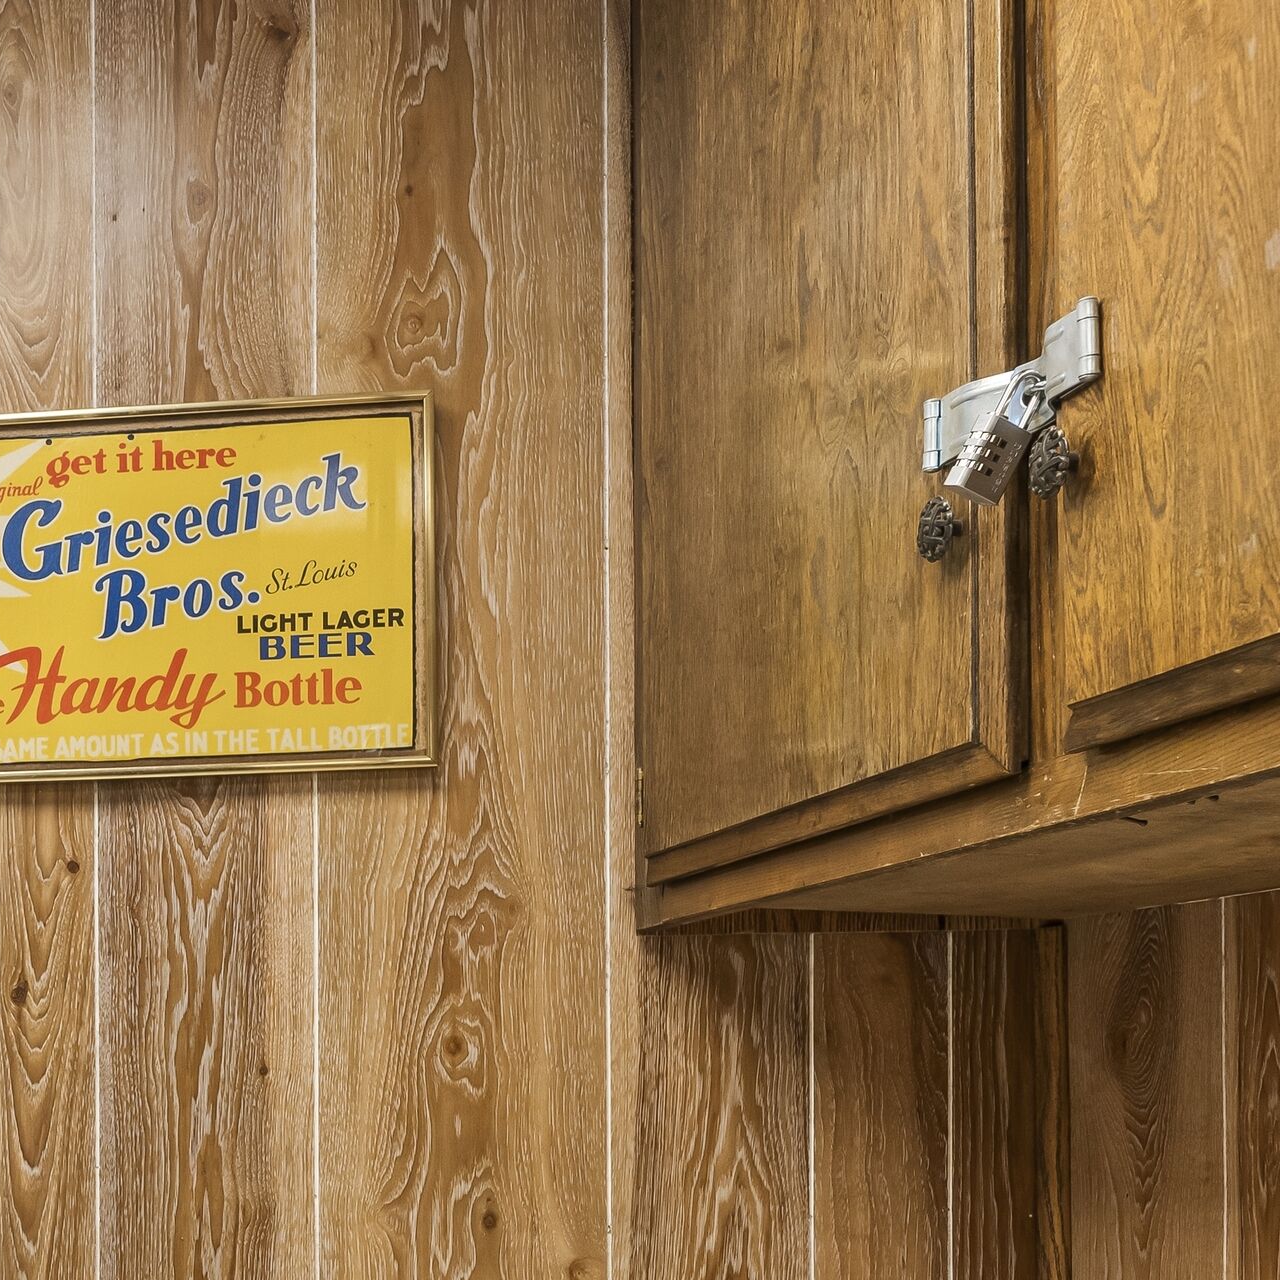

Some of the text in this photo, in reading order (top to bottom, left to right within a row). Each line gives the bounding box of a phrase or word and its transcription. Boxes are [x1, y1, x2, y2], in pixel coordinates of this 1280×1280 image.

[46, 440, 237, 488] get it here
[1, 451, 367, 581] Griesedieck
[95, 569, 261, 639] Bros.
[237, 608, 405, 634] LIGHT LAGER
[259, 631, 376, 660] BEER
[233, 668, 362, 708] Bottle
[55, 732, 144, 759] AMOUNT
[150, 731, 179, 755] AS
[185, 730, 207, 754] IN
[213, 728, 259, 753] THE
[266, 726, 323, 752] TALL
[329, 723, 409, 750] BOTTLE
